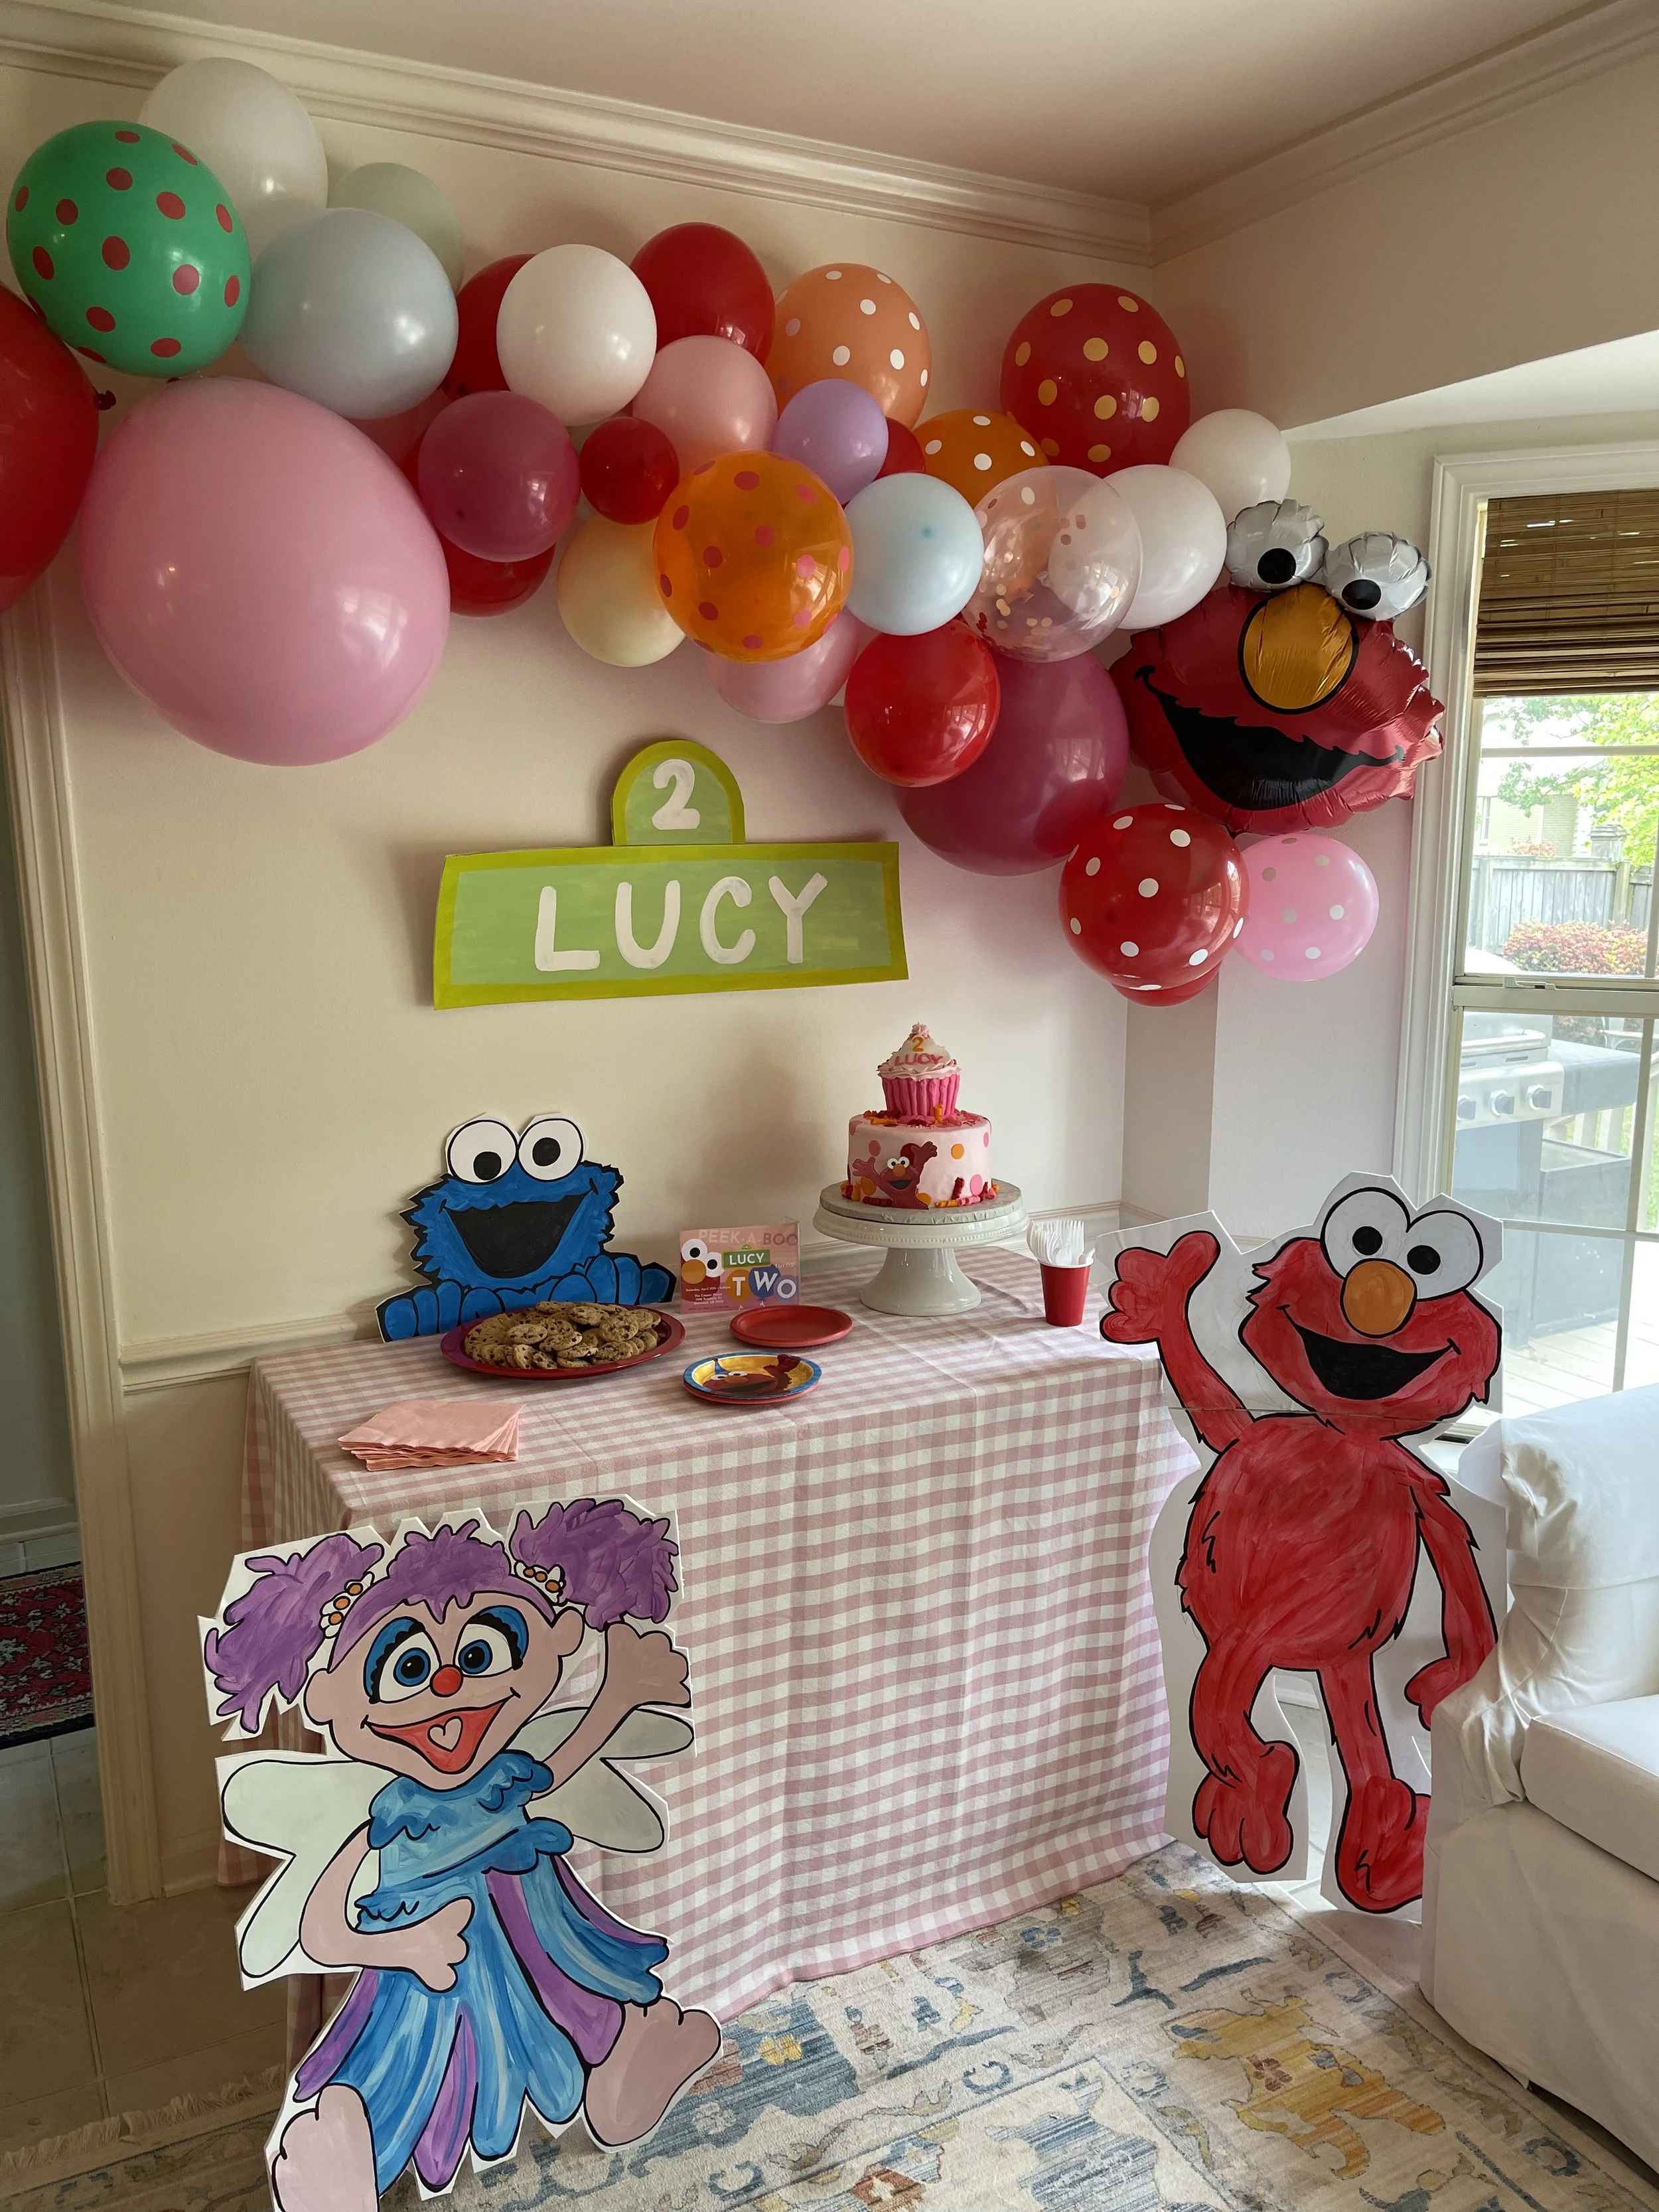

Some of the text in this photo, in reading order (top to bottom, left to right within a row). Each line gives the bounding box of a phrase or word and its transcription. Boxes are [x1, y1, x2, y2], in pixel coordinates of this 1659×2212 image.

[652, 759, 701, 830] 2
[534, 872, 828, 972] LUCY
[912, 1036, 924, 1052] 2
[894, 1053, 944, 1067] LUCY
[729, 1252, 765, 1266] LUCY
[732, 1270, 796, 1299] TWO
